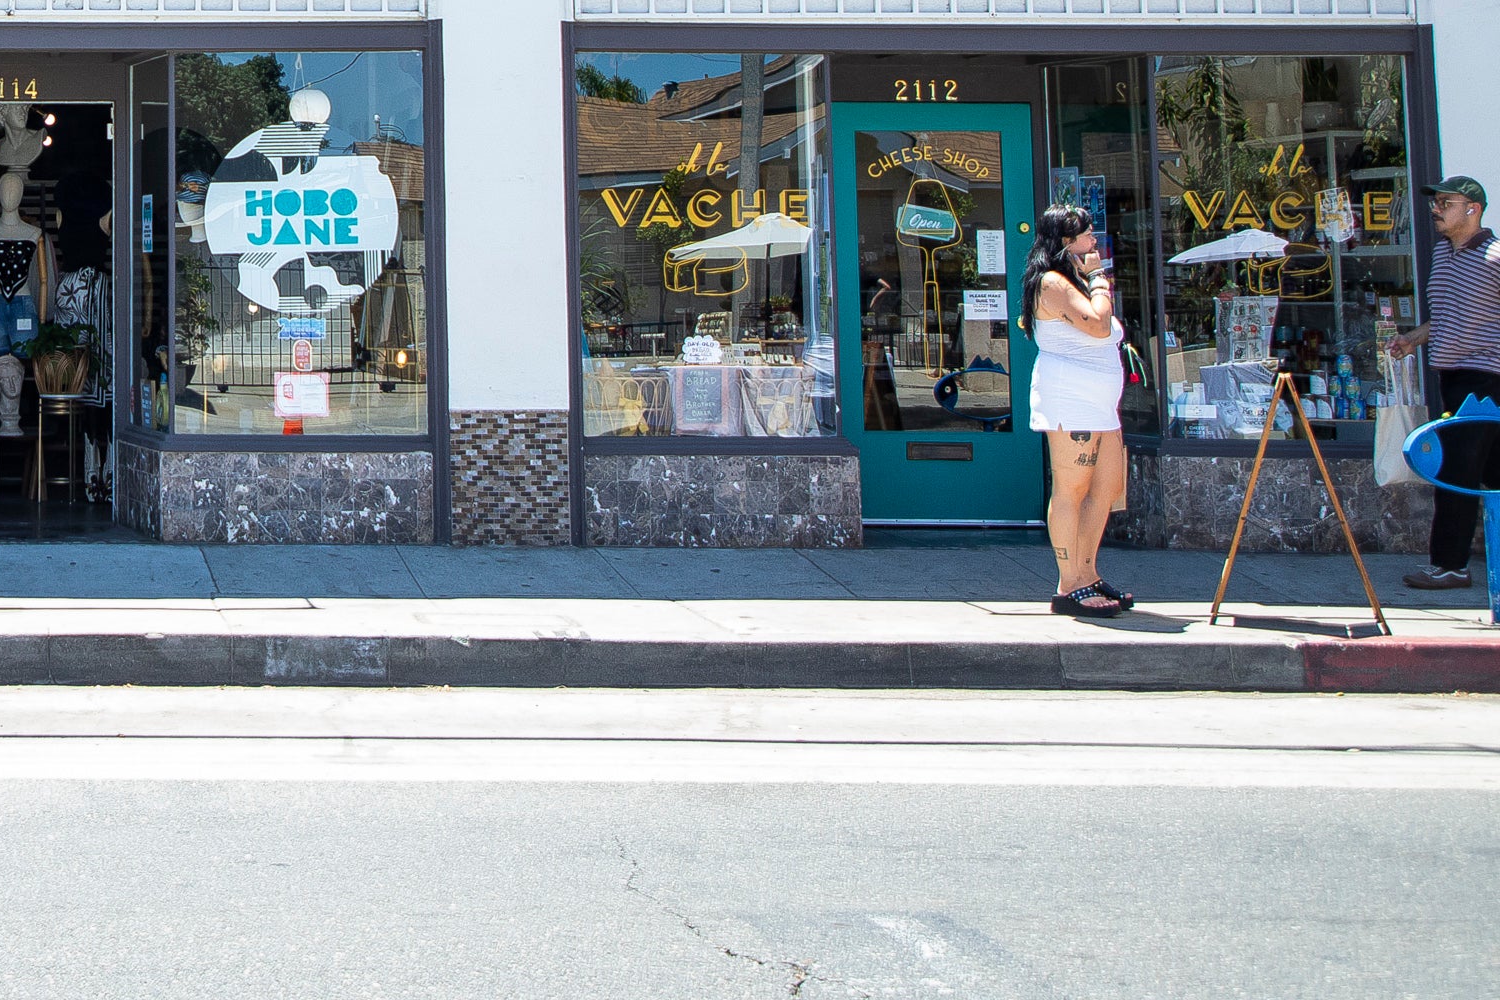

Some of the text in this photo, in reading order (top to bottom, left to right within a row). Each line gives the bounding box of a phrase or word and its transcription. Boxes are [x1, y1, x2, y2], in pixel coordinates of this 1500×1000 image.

[894, 79, 959, 101] 2112
[676, 141, 729, 176] oh la
[867, 146, 989, 178] CHEESE SHOP
[1259, 143, 1313, 178] oh la
[245, 188, 358, 216] HOBO
[601, 187, 810, 228] VACHE
[1182, 190, 1396, 231] VACHE
[247, 218, 359, 246] JANE
[909, 213, 943, 229] Open
[686, 376, 717, 385] BREAD
